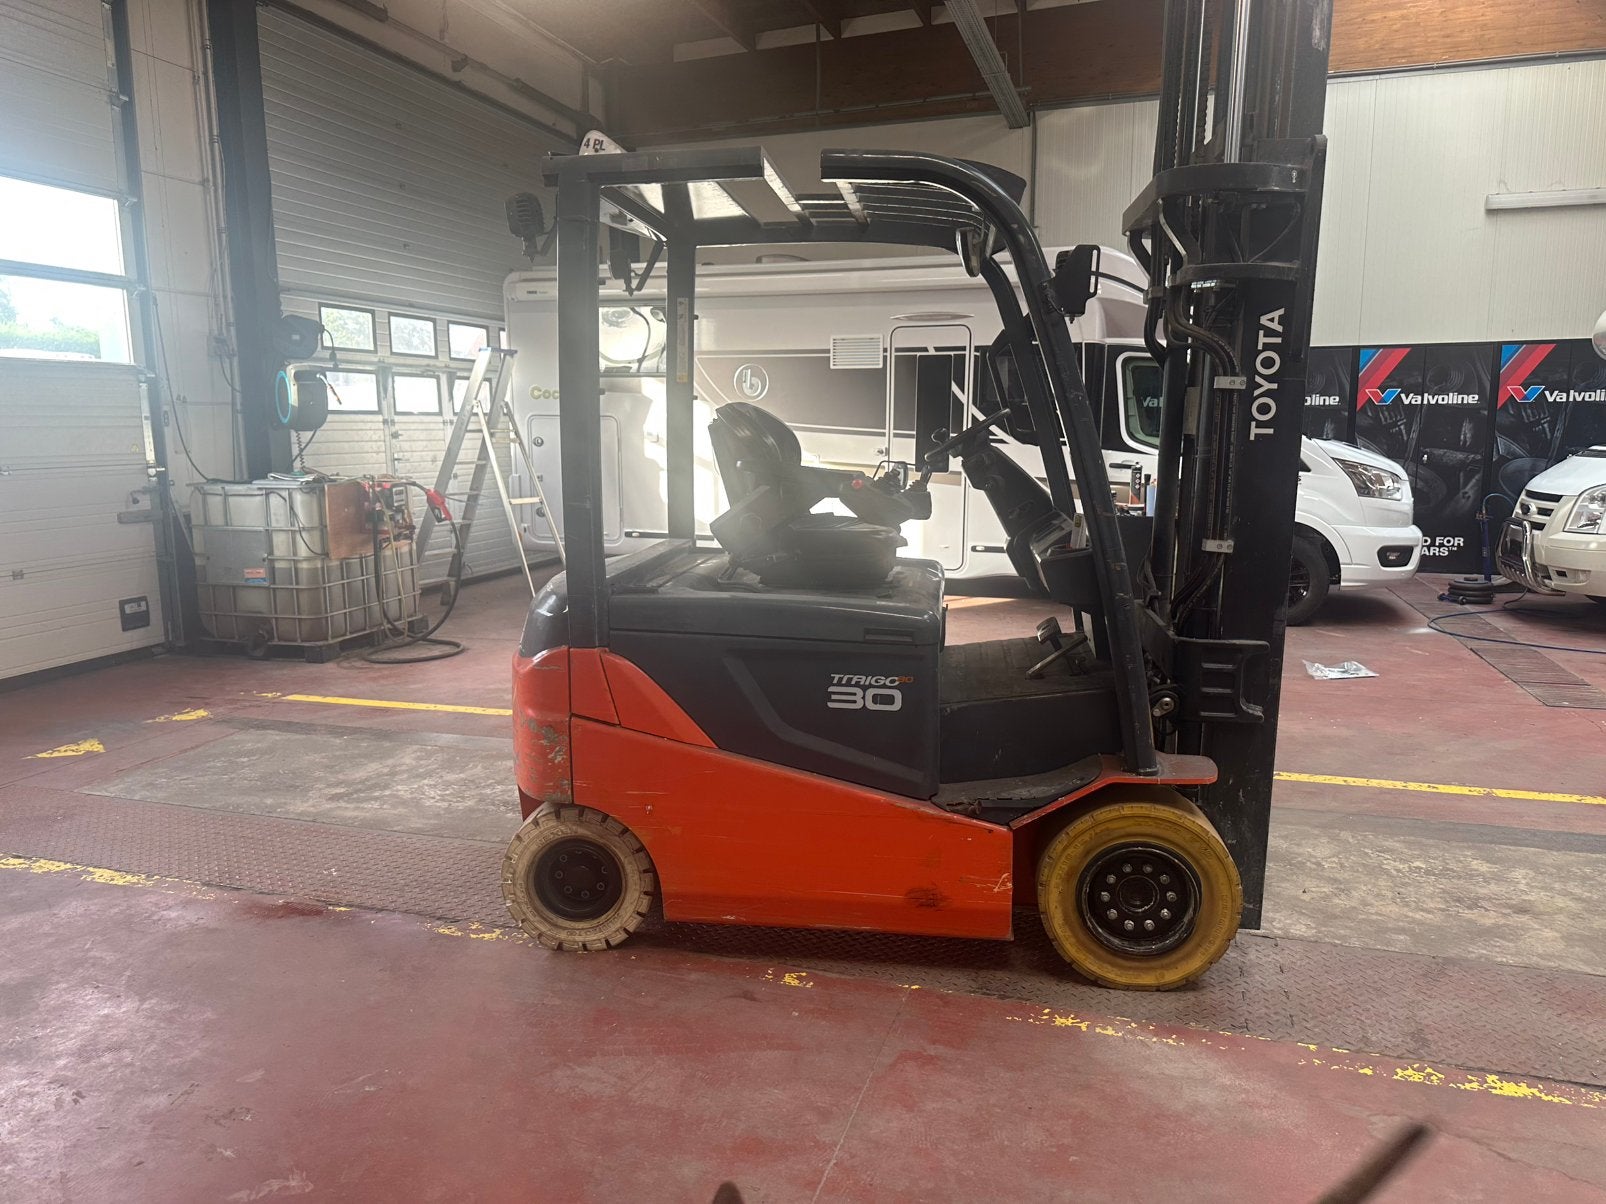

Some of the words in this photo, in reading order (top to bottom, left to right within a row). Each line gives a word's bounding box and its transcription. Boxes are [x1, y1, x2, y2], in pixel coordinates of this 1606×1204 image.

[583, 138, 591, 149] 4
[1249, 307, 1285, 441] TOYOTA
[1400, 392, 1479, 405] Valvoline
[1544, 389, 1606, 402] Valvoli
[1435, 537, 1464, 547] FOR
[827, 686, 902, 711] 30
